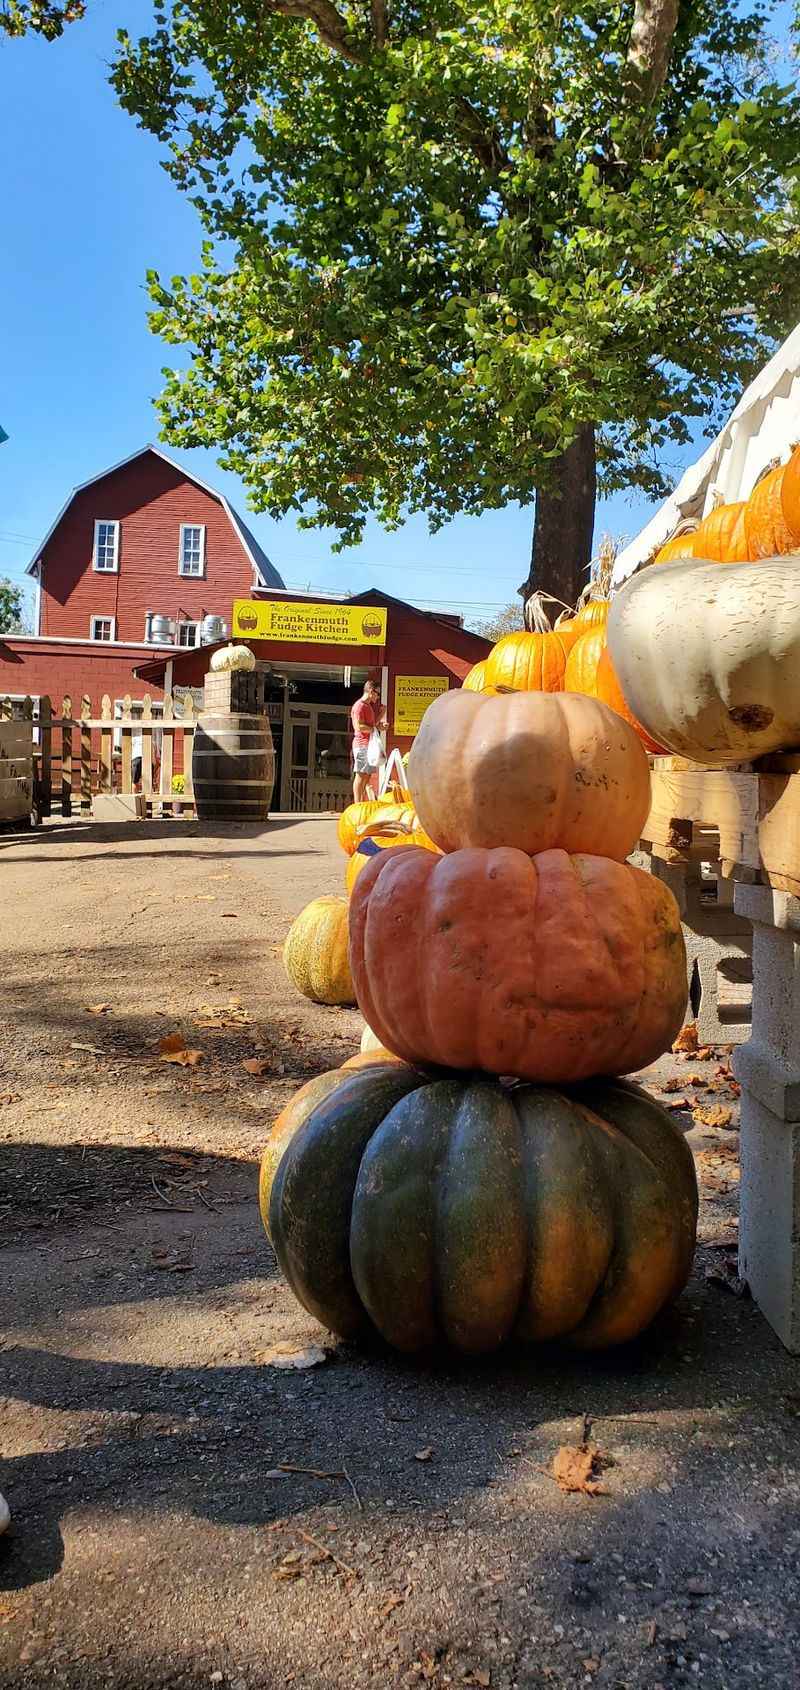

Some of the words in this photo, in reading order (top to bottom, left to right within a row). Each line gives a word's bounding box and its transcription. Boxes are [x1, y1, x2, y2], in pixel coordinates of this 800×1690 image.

[270, 613, 349, 625] Frankenmuth
[270, 622, 304, 632] Fudge
[306, 623, 349, 634] Kitchen
[259, 632, 358, 642] www.frankenmuthfudge.com
